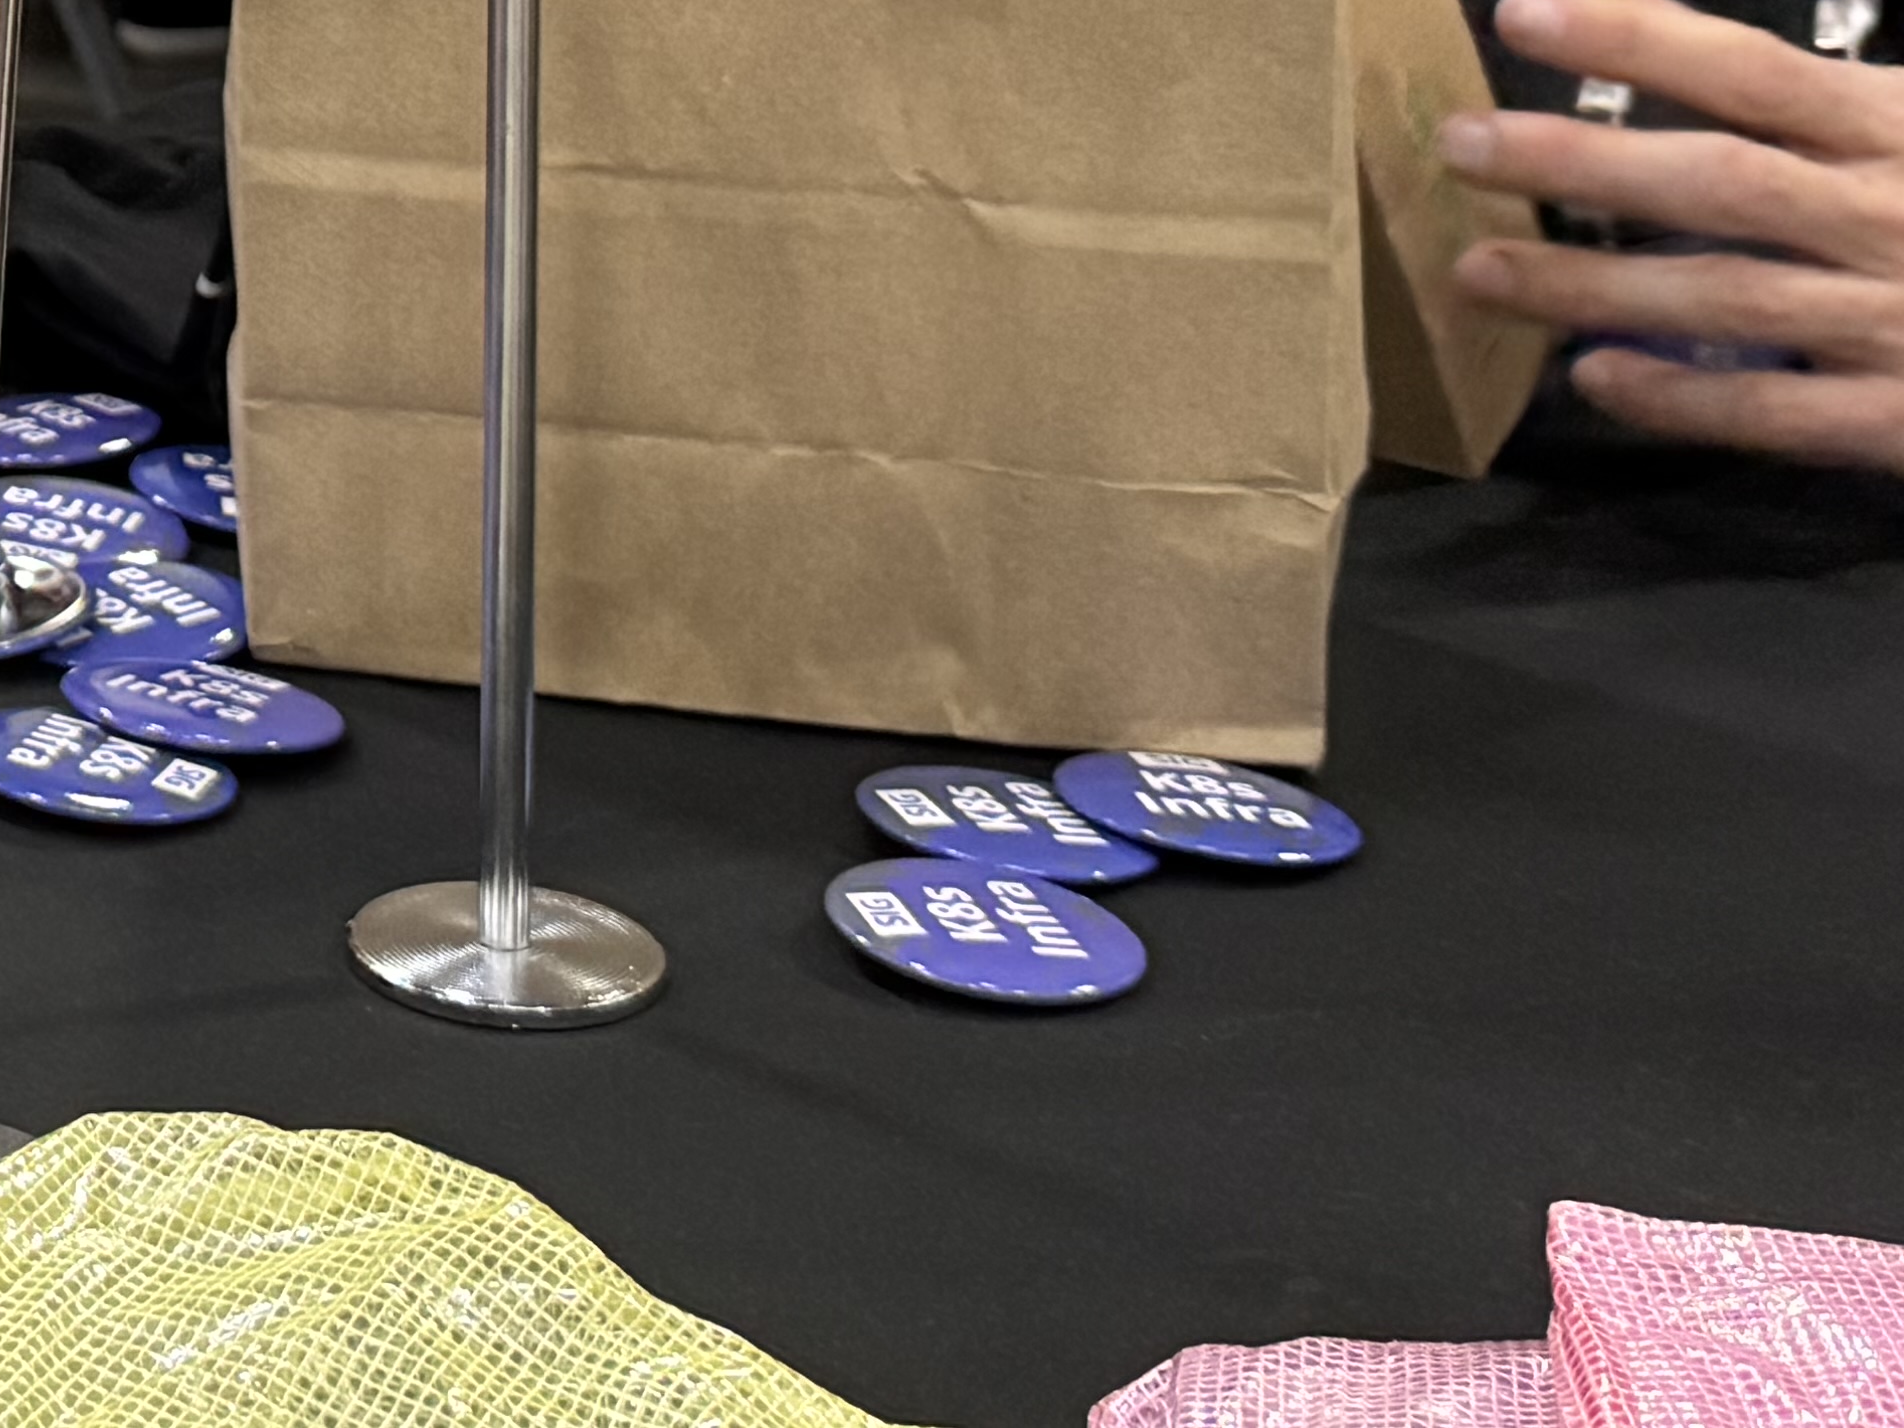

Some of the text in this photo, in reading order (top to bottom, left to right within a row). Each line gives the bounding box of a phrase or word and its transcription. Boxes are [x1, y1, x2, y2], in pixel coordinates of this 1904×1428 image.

[0, 511, 106, 551] K8s
[2, 485, 146, 533] Infra
[106, 564, 222, 627] Infra
[105, 673, 259, 723] Infra
[6, 712, 102, 769] Infra
[79, 735, 157, 781] K8s
[168, 763, 209, 791] SIG
[1139, 769, 1269, 802] K8s
[895, 788, 942, 819] SIG
[946, 784, 1033, 834] K8s
[1003, 781, 1111, 846] Infra
[1134, 790, 1314, 831] Infra
[864, 896, 910, 930] SIG
[922, 885, 1009, 943] K8s
[985, 879, 1090, 959] Infra
